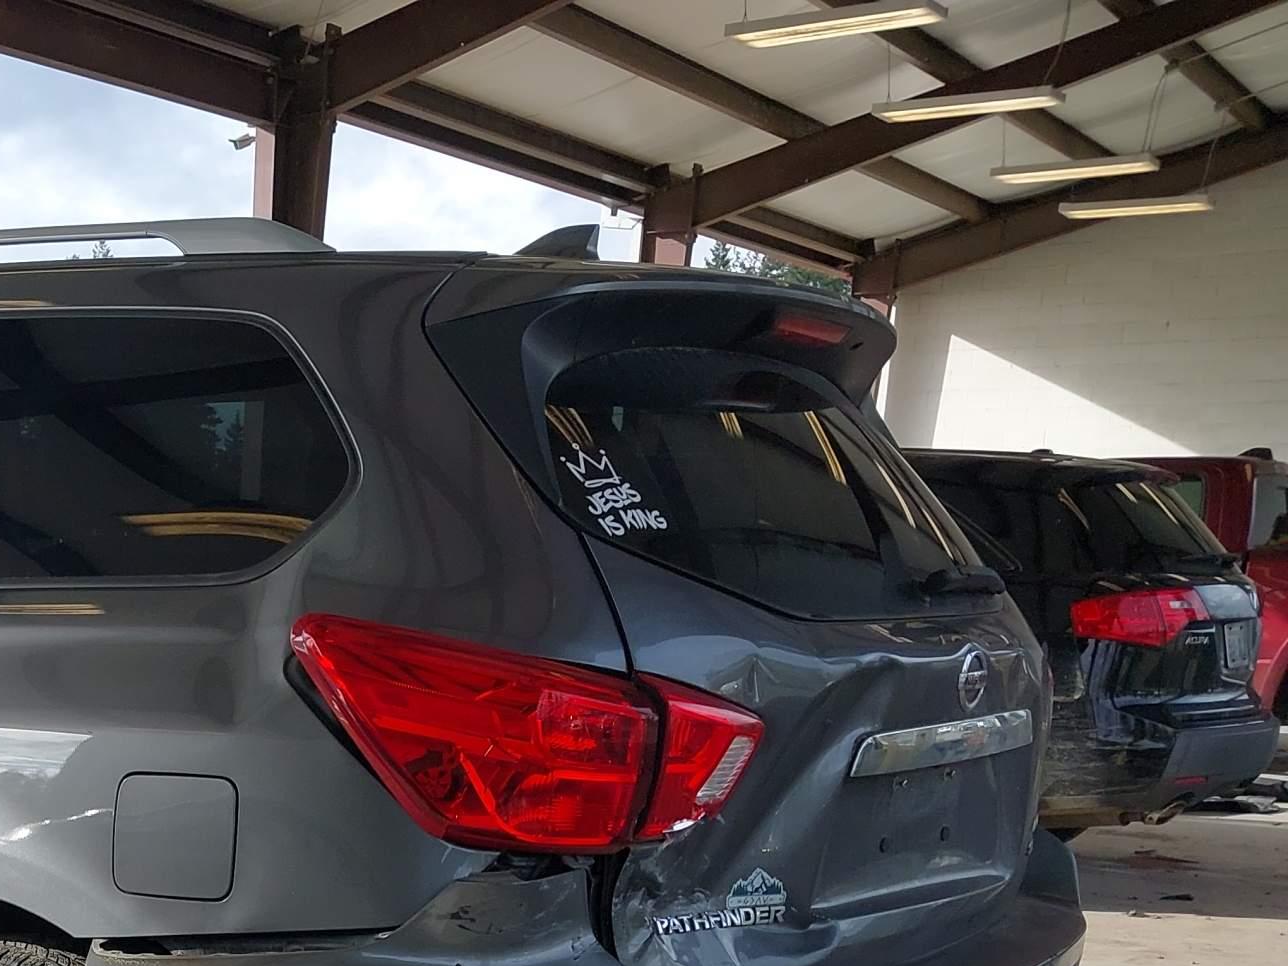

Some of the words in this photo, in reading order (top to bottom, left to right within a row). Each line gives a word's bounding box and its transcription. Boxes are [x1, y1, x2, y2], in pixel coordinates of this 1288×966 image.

[586, 483, 642, 515] JESUS
[598, 515, 625, 536] IS
[619, 509, 668, 530] KING
[654, 906, 786, 935] PATHFINDER
